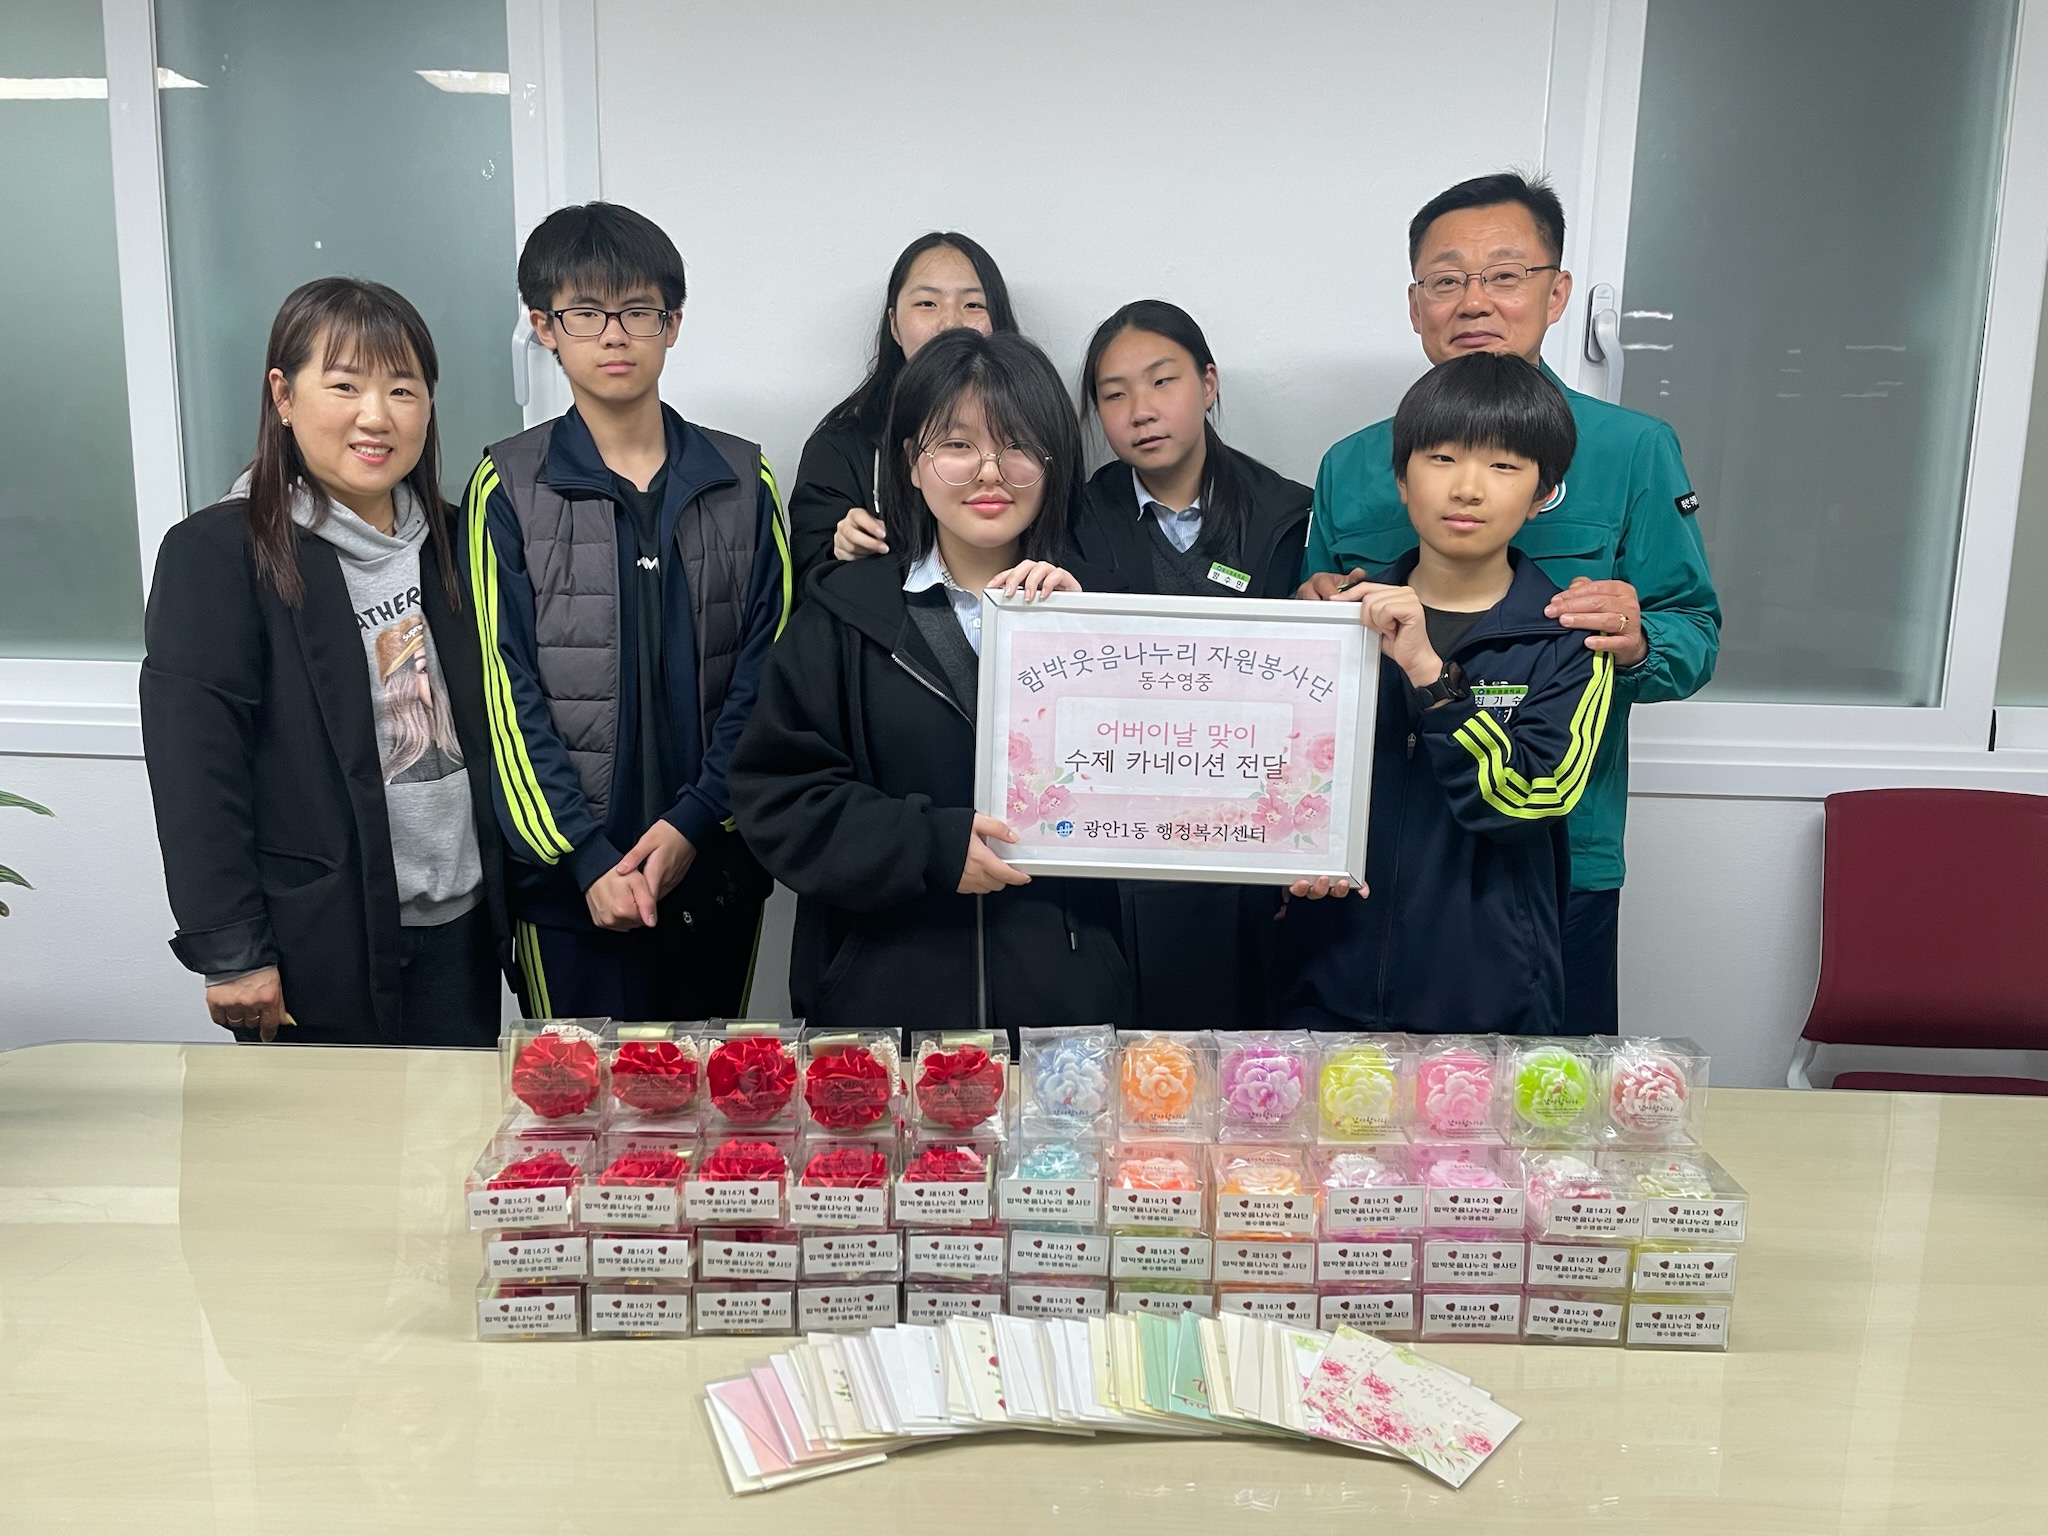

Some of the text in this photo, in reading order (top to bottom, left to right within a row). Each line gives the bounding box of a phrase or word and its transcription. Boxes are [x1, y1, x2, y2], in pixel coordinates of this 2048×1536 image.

[1017, 642, 1334, 703] 함박웃음나누리 자원봉사단
[1138, 672, 1214, 692] 동수영중
[1096, 720, 1256, 749] 어버이날 맞이
[1064, 748, 1288, 780] 수제 카네이션 전달
[1083, 820, 1266, 843] 광안1동 행정복지센터
